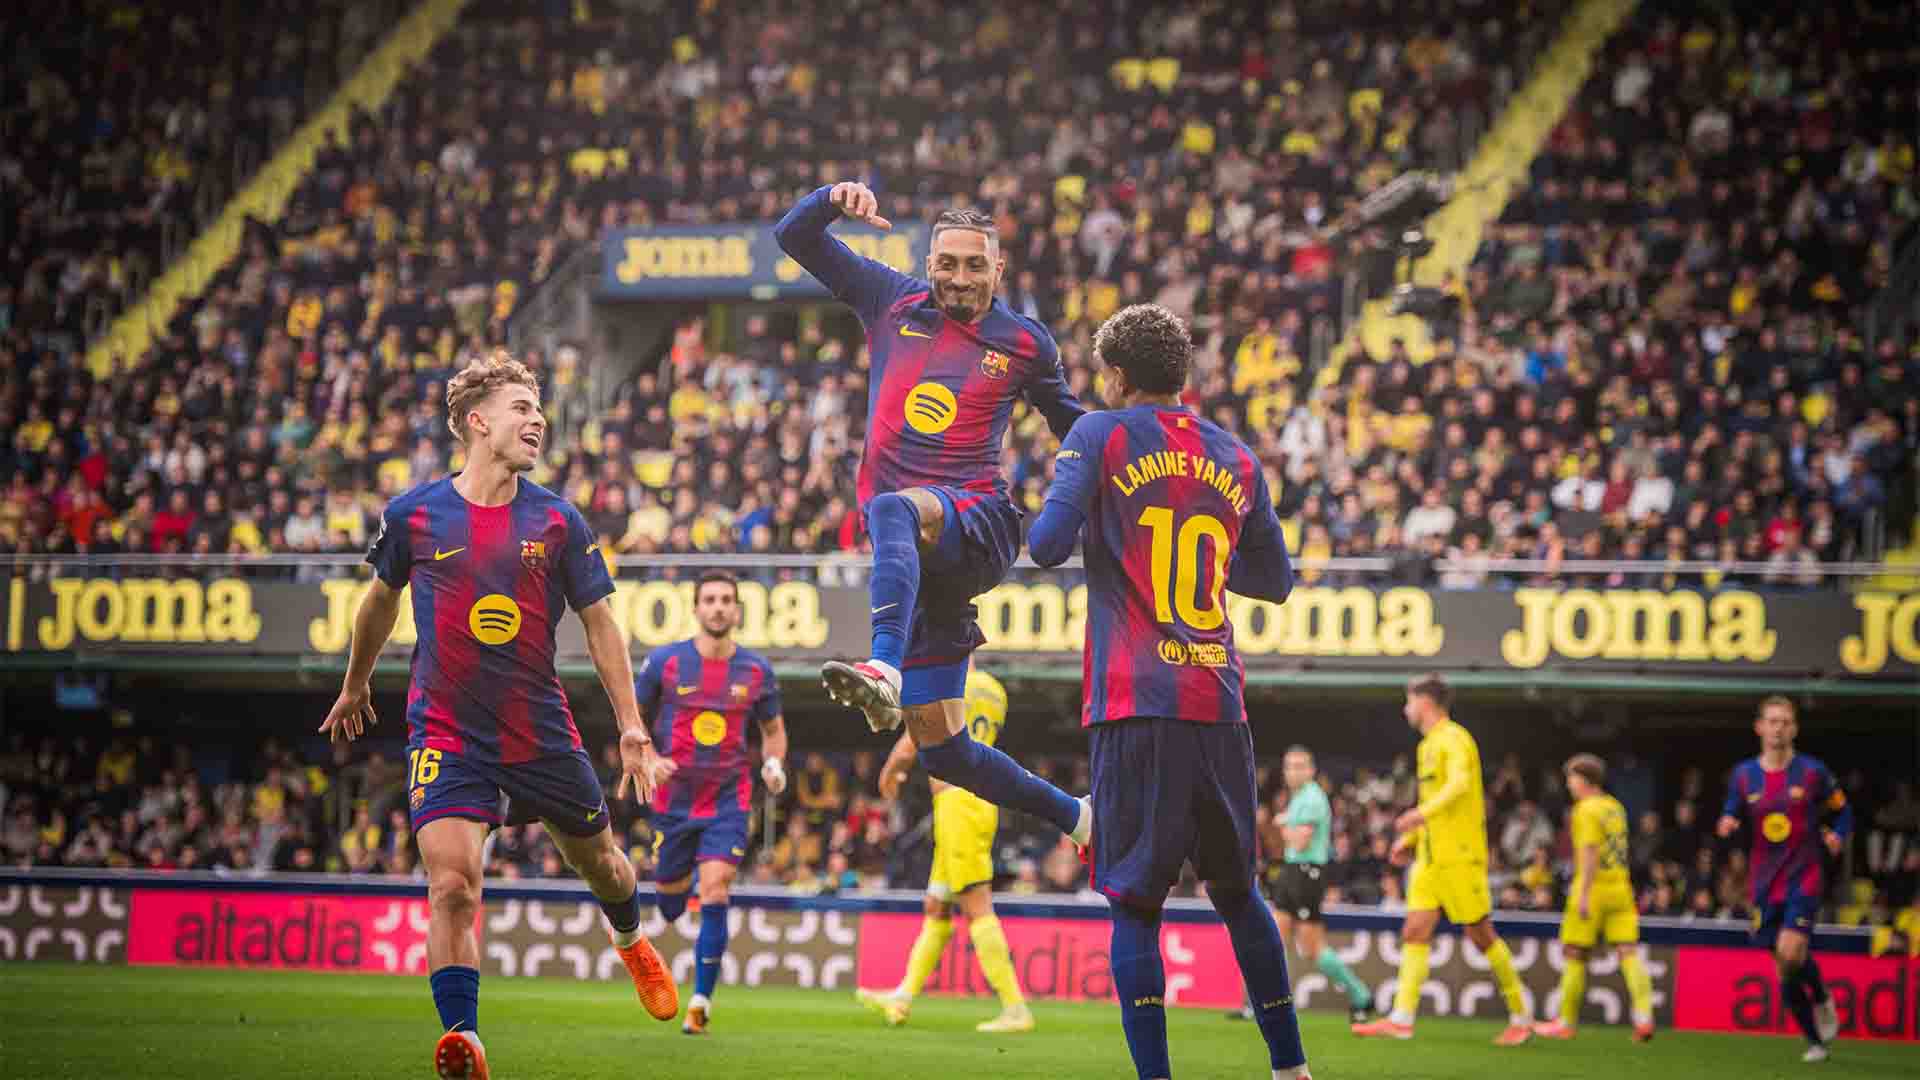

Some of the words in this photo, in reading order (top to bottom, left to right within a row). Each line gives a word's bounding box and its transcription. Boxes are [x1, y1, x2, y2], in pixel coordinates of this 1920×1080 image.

[1111, 450, 1188, 497] LAMINE
[1191, 455, 1249, 515] YAMAL
[1137, 505, 1231, 631] 10
[410, 747, 442, 791] 16
[174, 898, 363, 966] altadia
